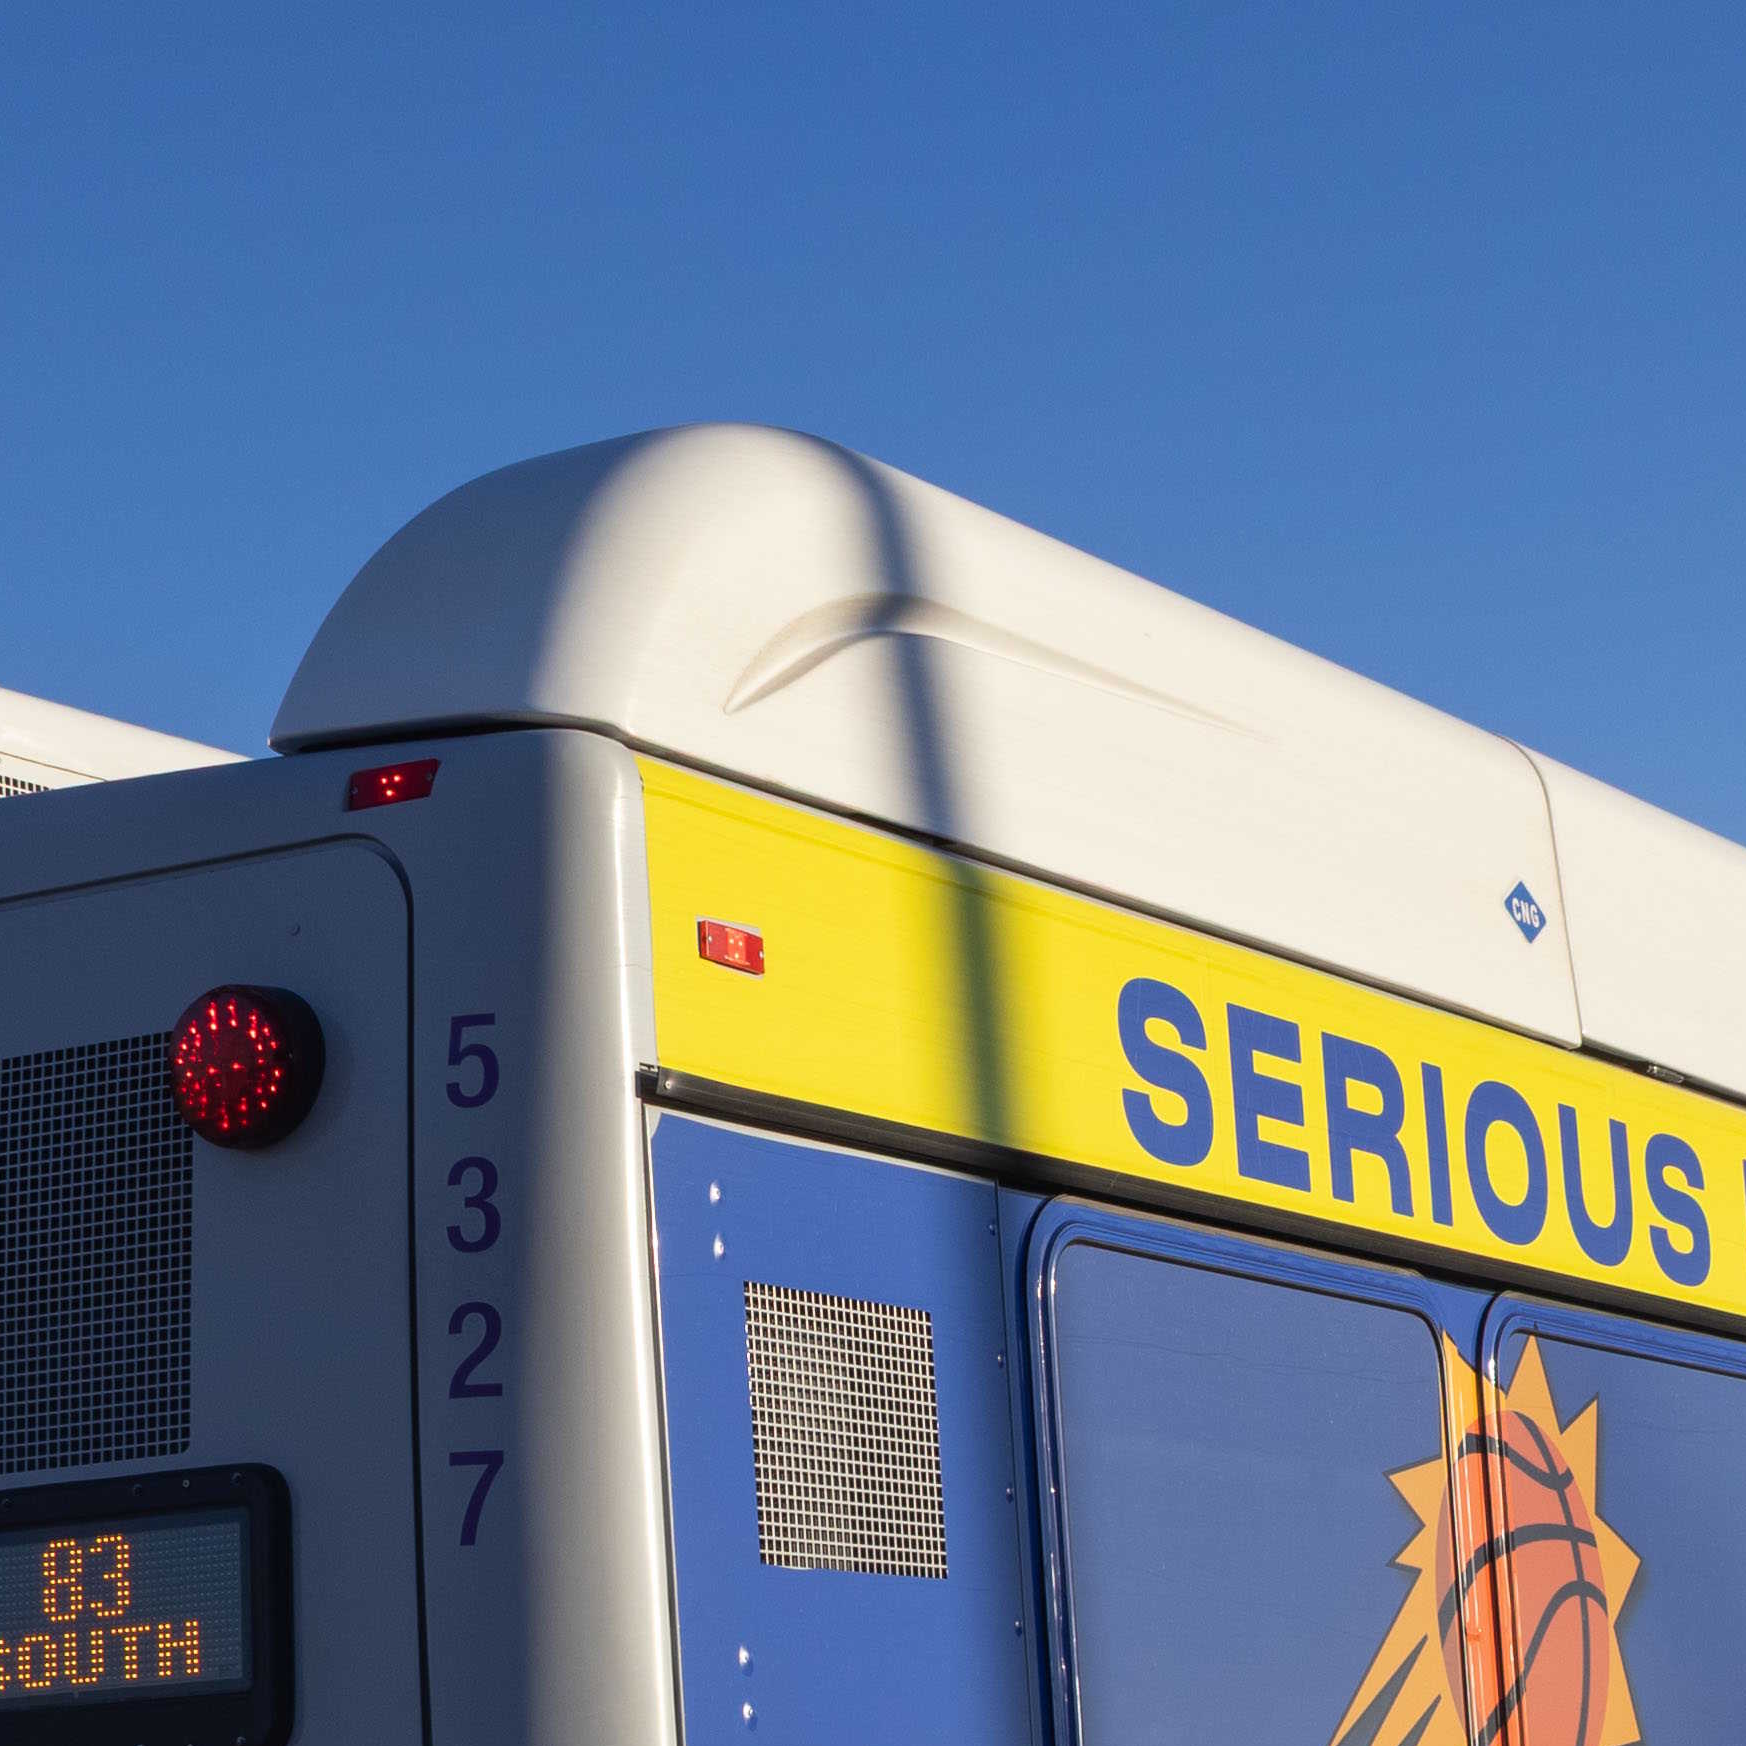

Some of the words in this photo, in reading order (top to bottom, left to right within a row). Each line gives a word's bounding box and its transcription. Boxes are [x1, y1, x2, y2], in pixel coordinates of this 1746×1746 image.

[1512, 898, 1540, 928] CNG
[1117, 977, 1712, 1287] SERIOUS
[42, 1533, 130, 1623] 83
